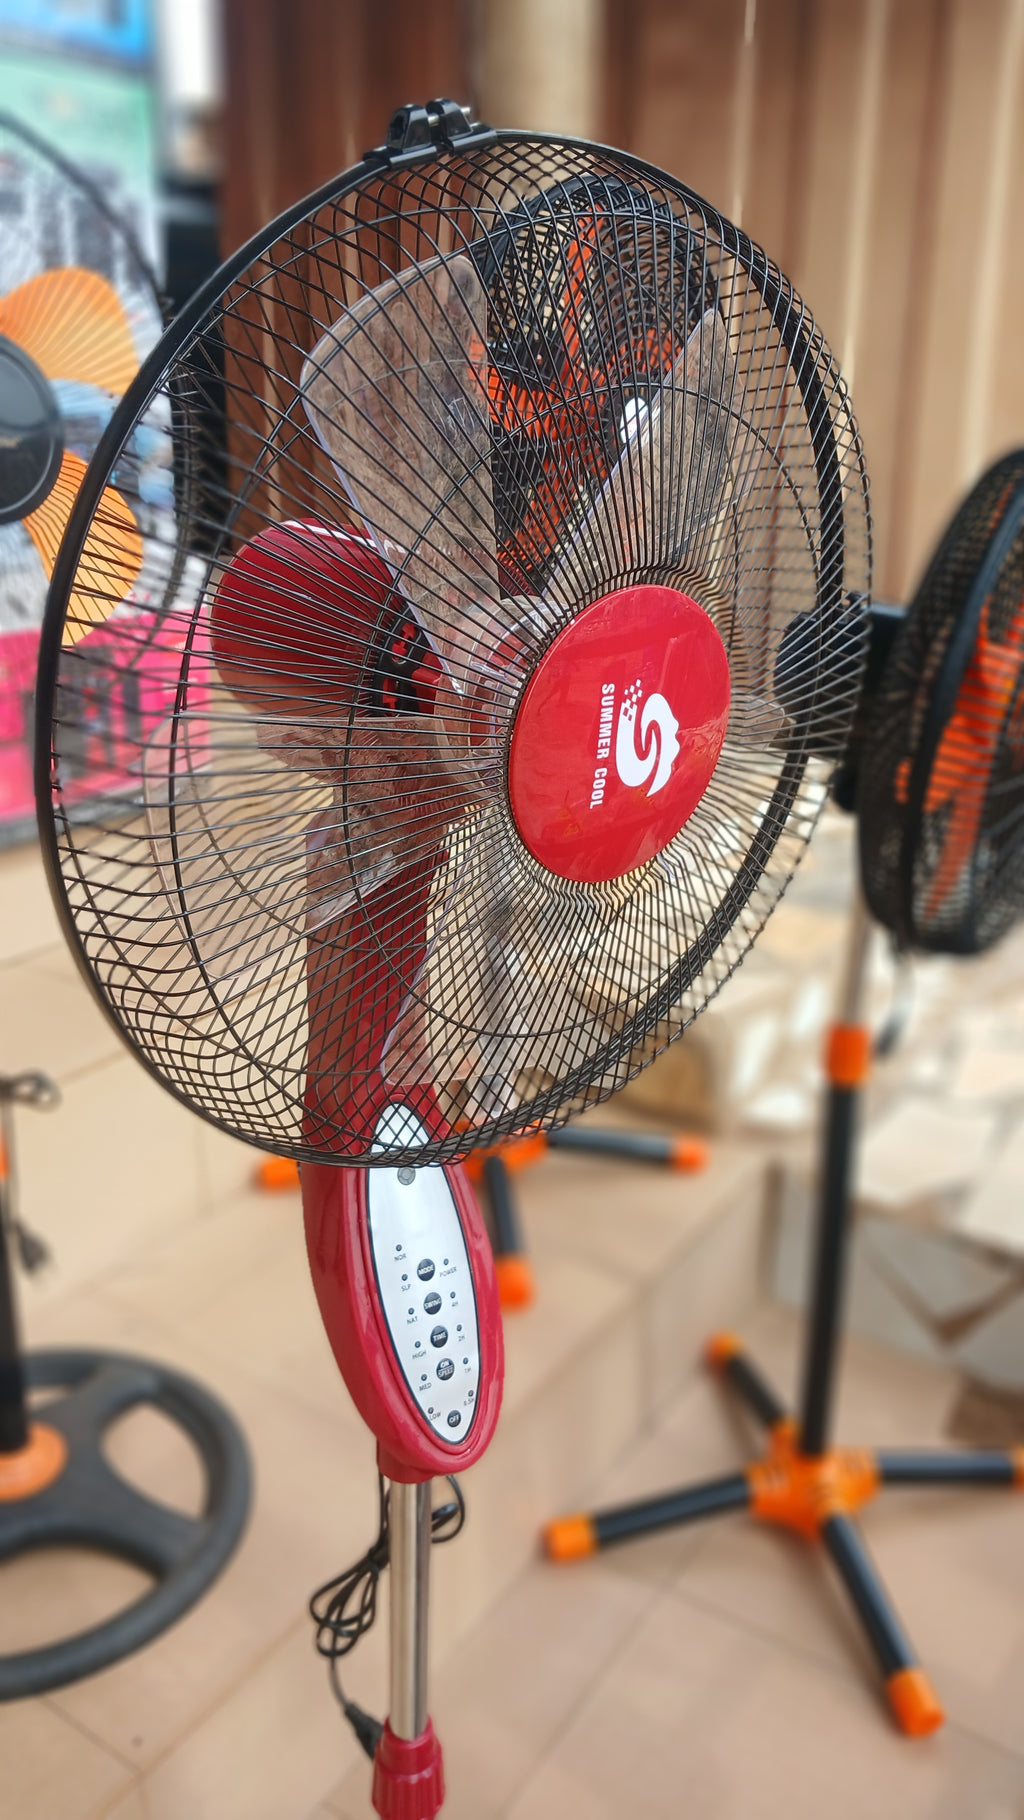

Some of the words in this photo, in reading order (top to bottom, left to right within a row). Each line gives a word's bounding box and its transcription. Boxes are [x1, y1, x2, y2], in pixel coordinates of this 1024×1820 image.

[596, 683, 615, 760] SUMMER
[589, 767, 607, 810] COOL
[418, 1265, 434, 1275] MODE
[440, 1267, 457, 1277] POWER
[407, 1316, 418, 1324] NAT
[412, 1350, 427, 1359] HIGH
[419, 1382, 432, 1391] MED
[430, 1411, 441, 1421] LOW
